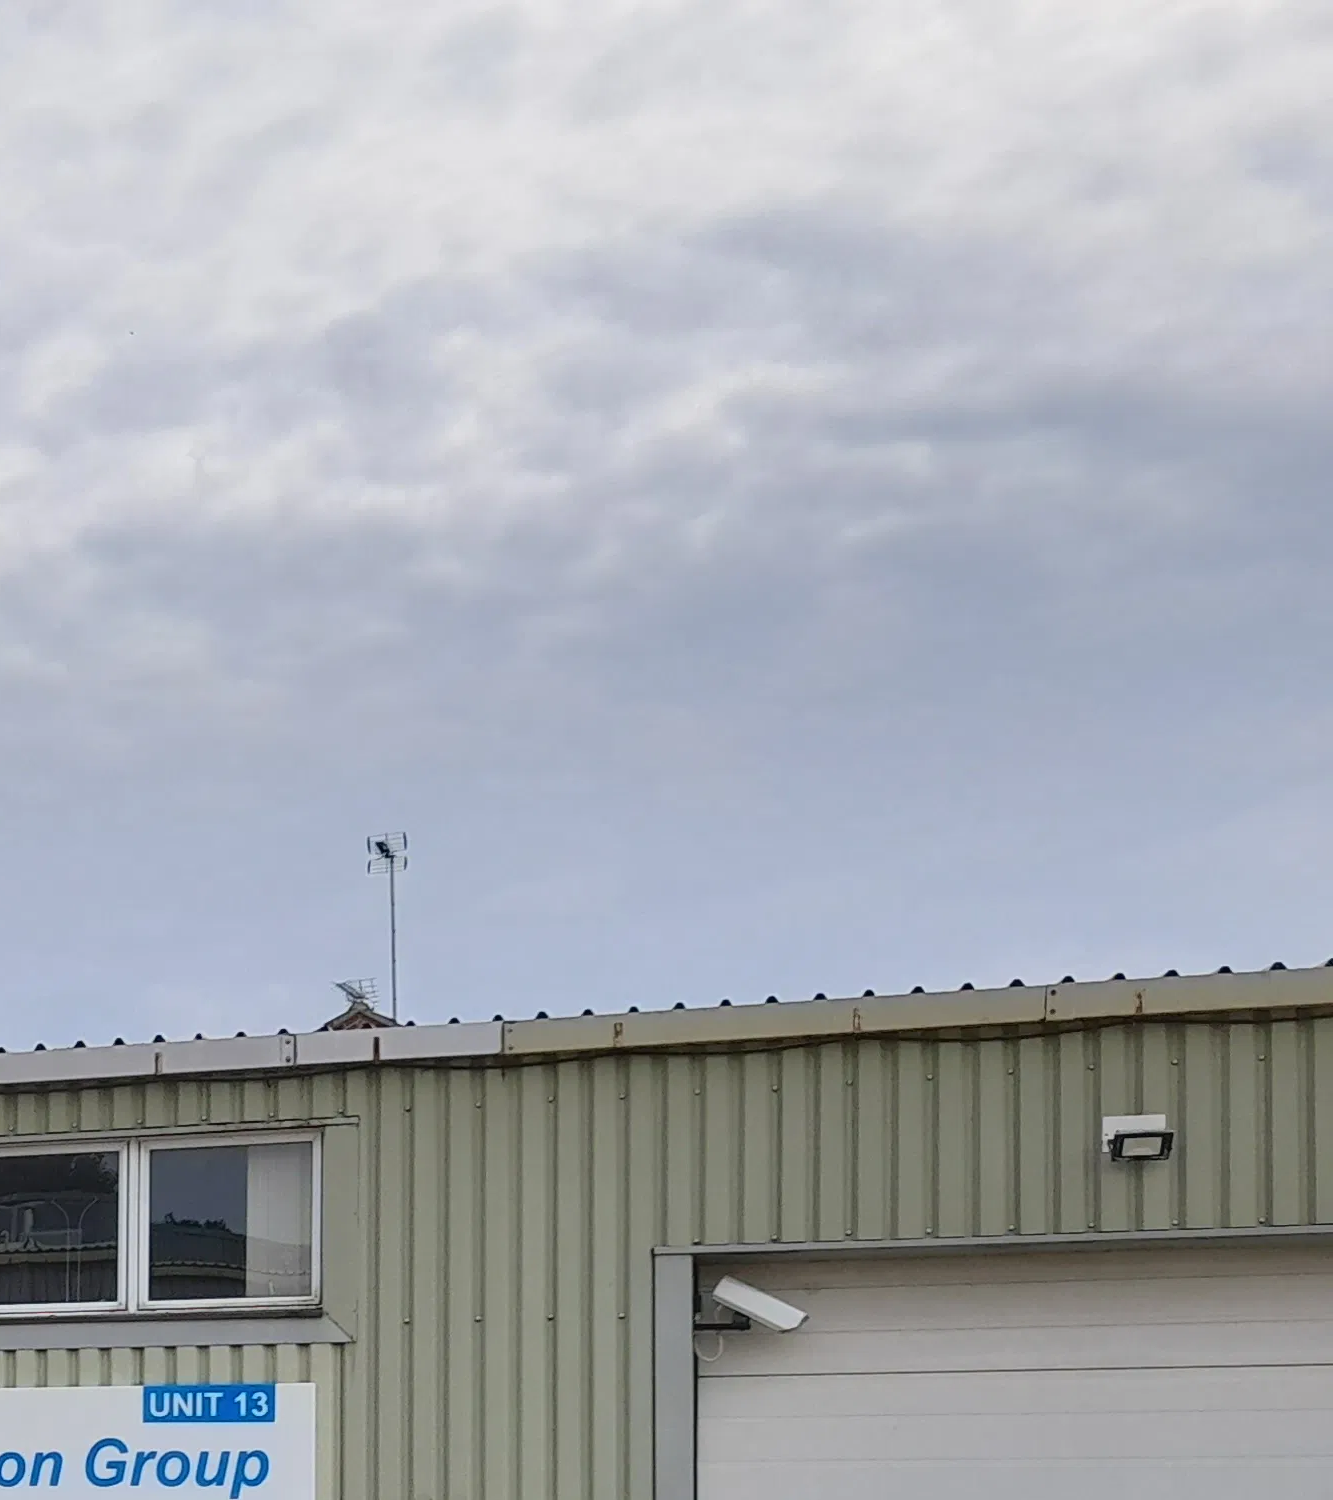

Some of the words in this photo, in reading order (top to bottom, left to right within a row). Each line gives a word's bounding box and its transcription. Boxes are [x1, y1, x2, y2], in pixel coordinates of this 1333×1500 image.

[149, 1392, 223, 1417] UNIT
[234, 1391, 269, 1417] 13
[85, 1437, 270, 1500] Group
